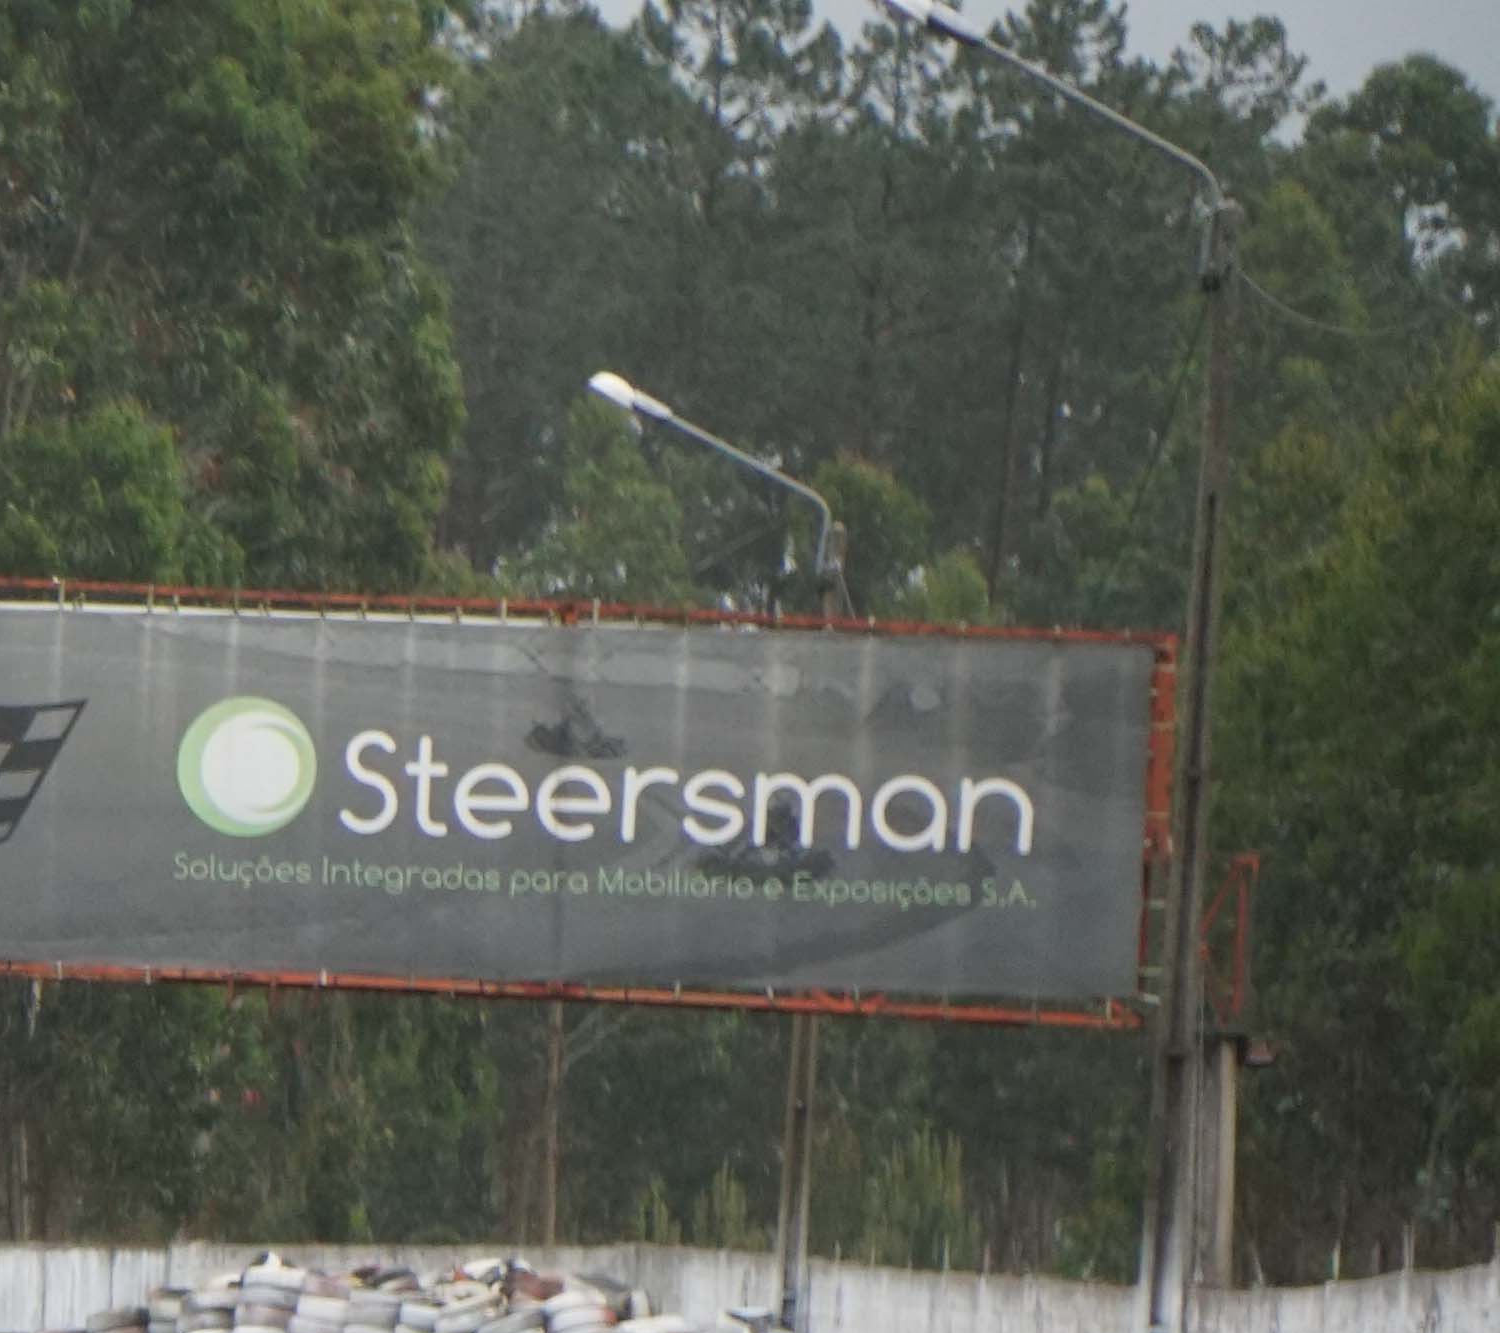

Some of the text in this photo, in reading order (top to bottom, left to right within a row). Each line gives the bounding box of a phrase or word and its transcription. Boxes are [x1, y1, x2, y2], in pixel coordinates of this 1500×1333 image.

[337, 728, 1035, 857] Steersman
[172, 850, 311, 889] Soluções
[320, 855, 501, 896] Integradas
[508, 867, 589, 897] para
[762, 875, 785, 899] e
